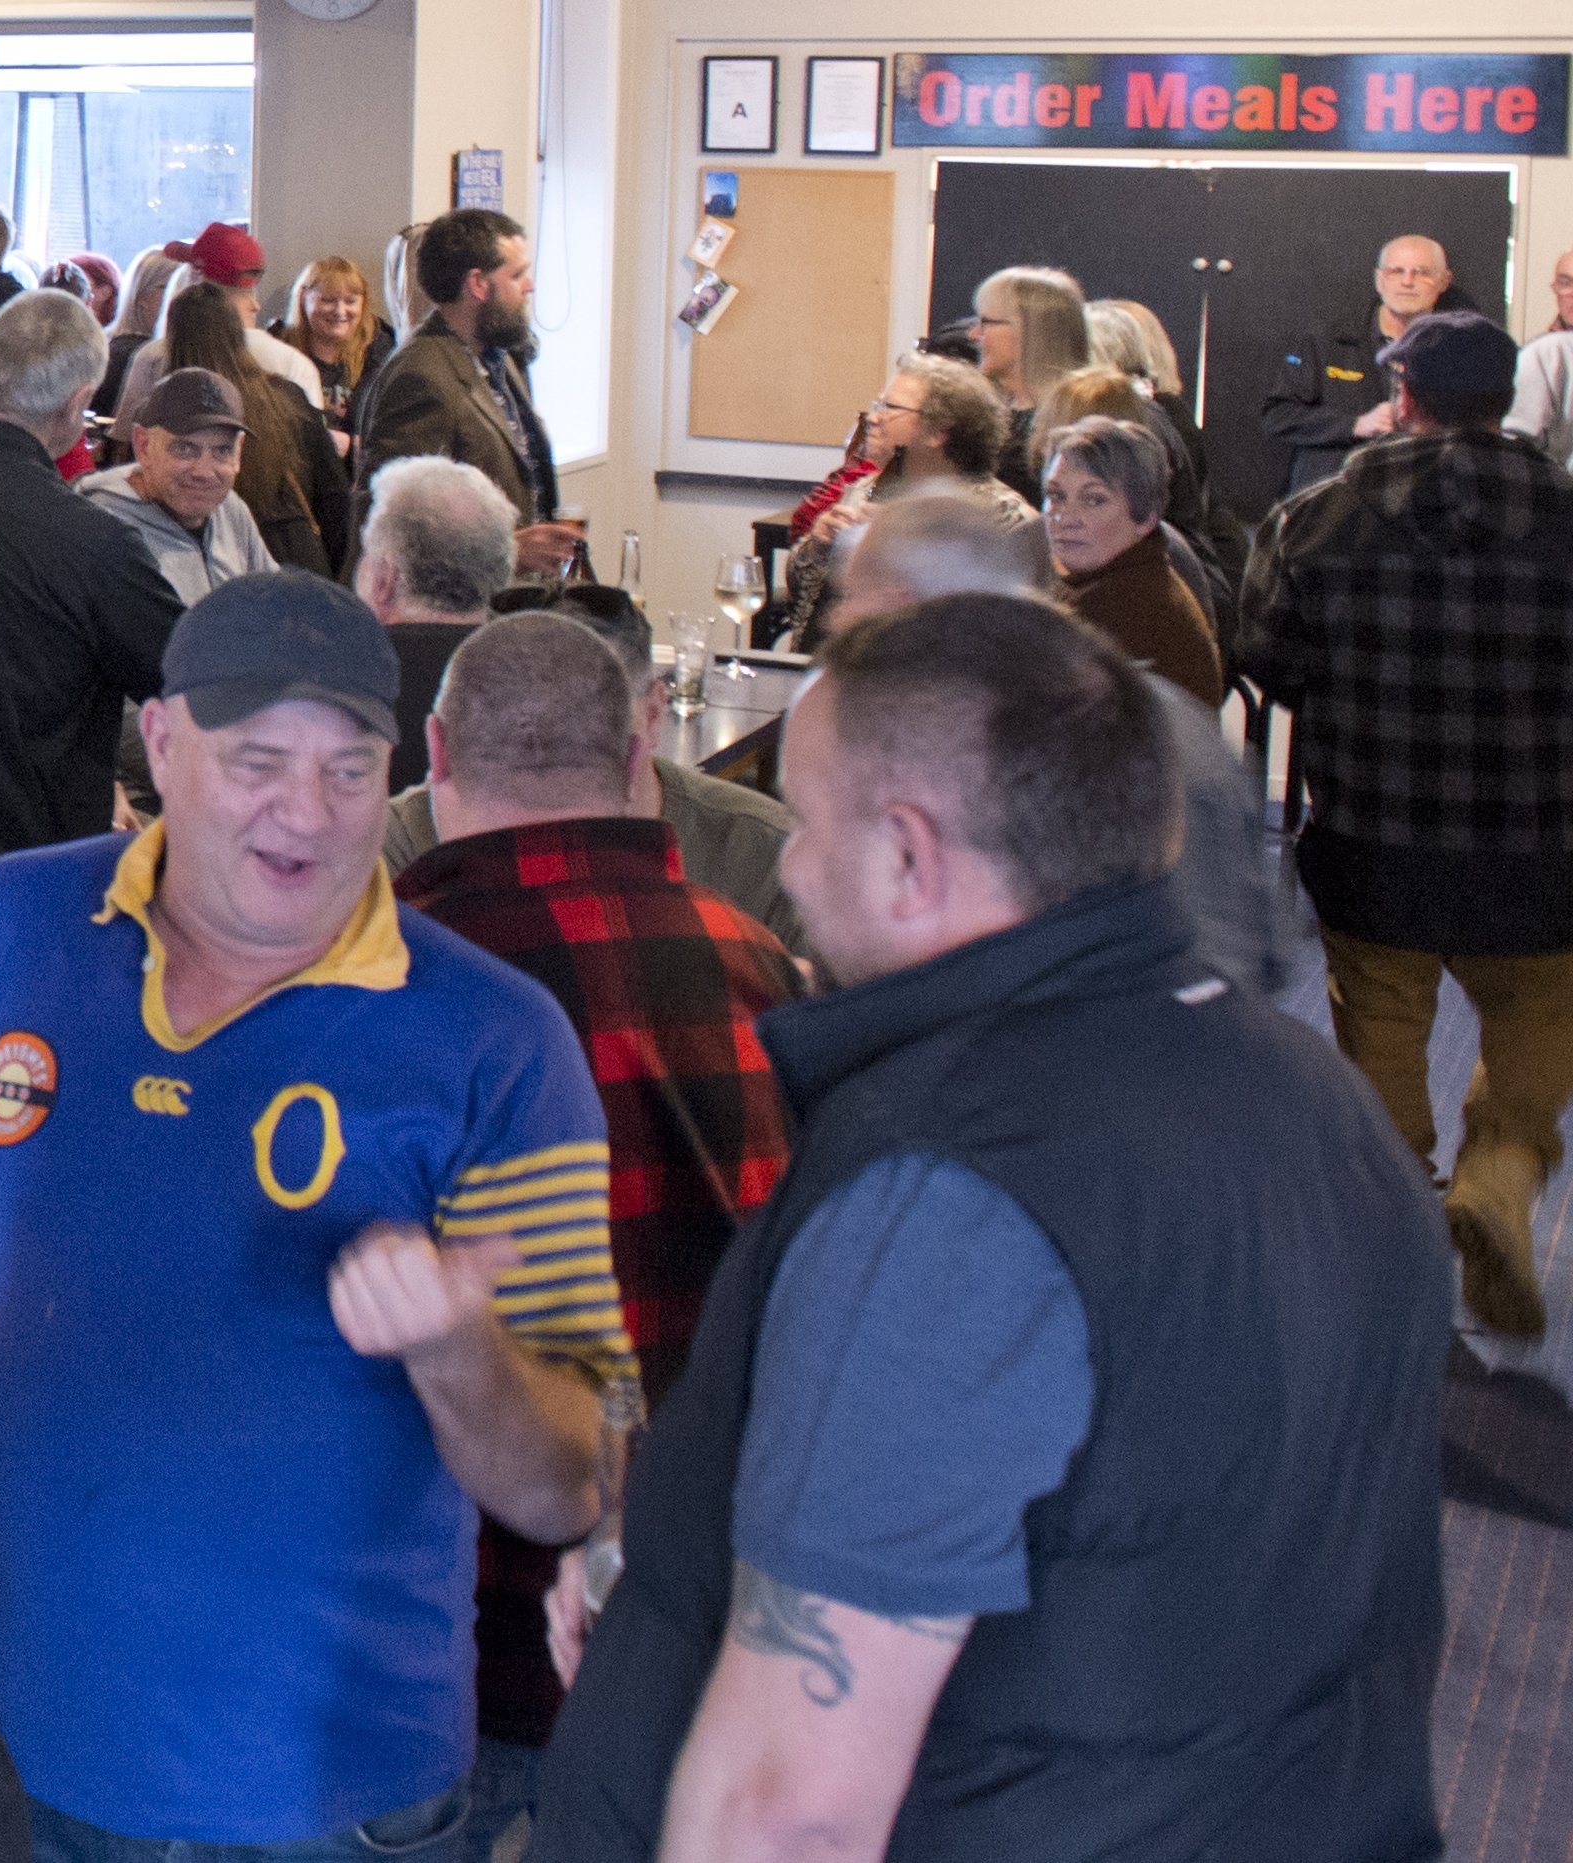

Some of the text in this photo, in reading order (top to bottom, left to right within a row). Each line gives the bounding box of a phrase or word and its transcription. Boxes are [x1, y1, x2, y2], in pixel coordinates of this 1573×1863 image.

[732, 102, 748, 119] A
[918, 70, 1101, 128] Order
[1125, 71, 1339, 132] Meals
[1363, 73, 1538, 135] Here
